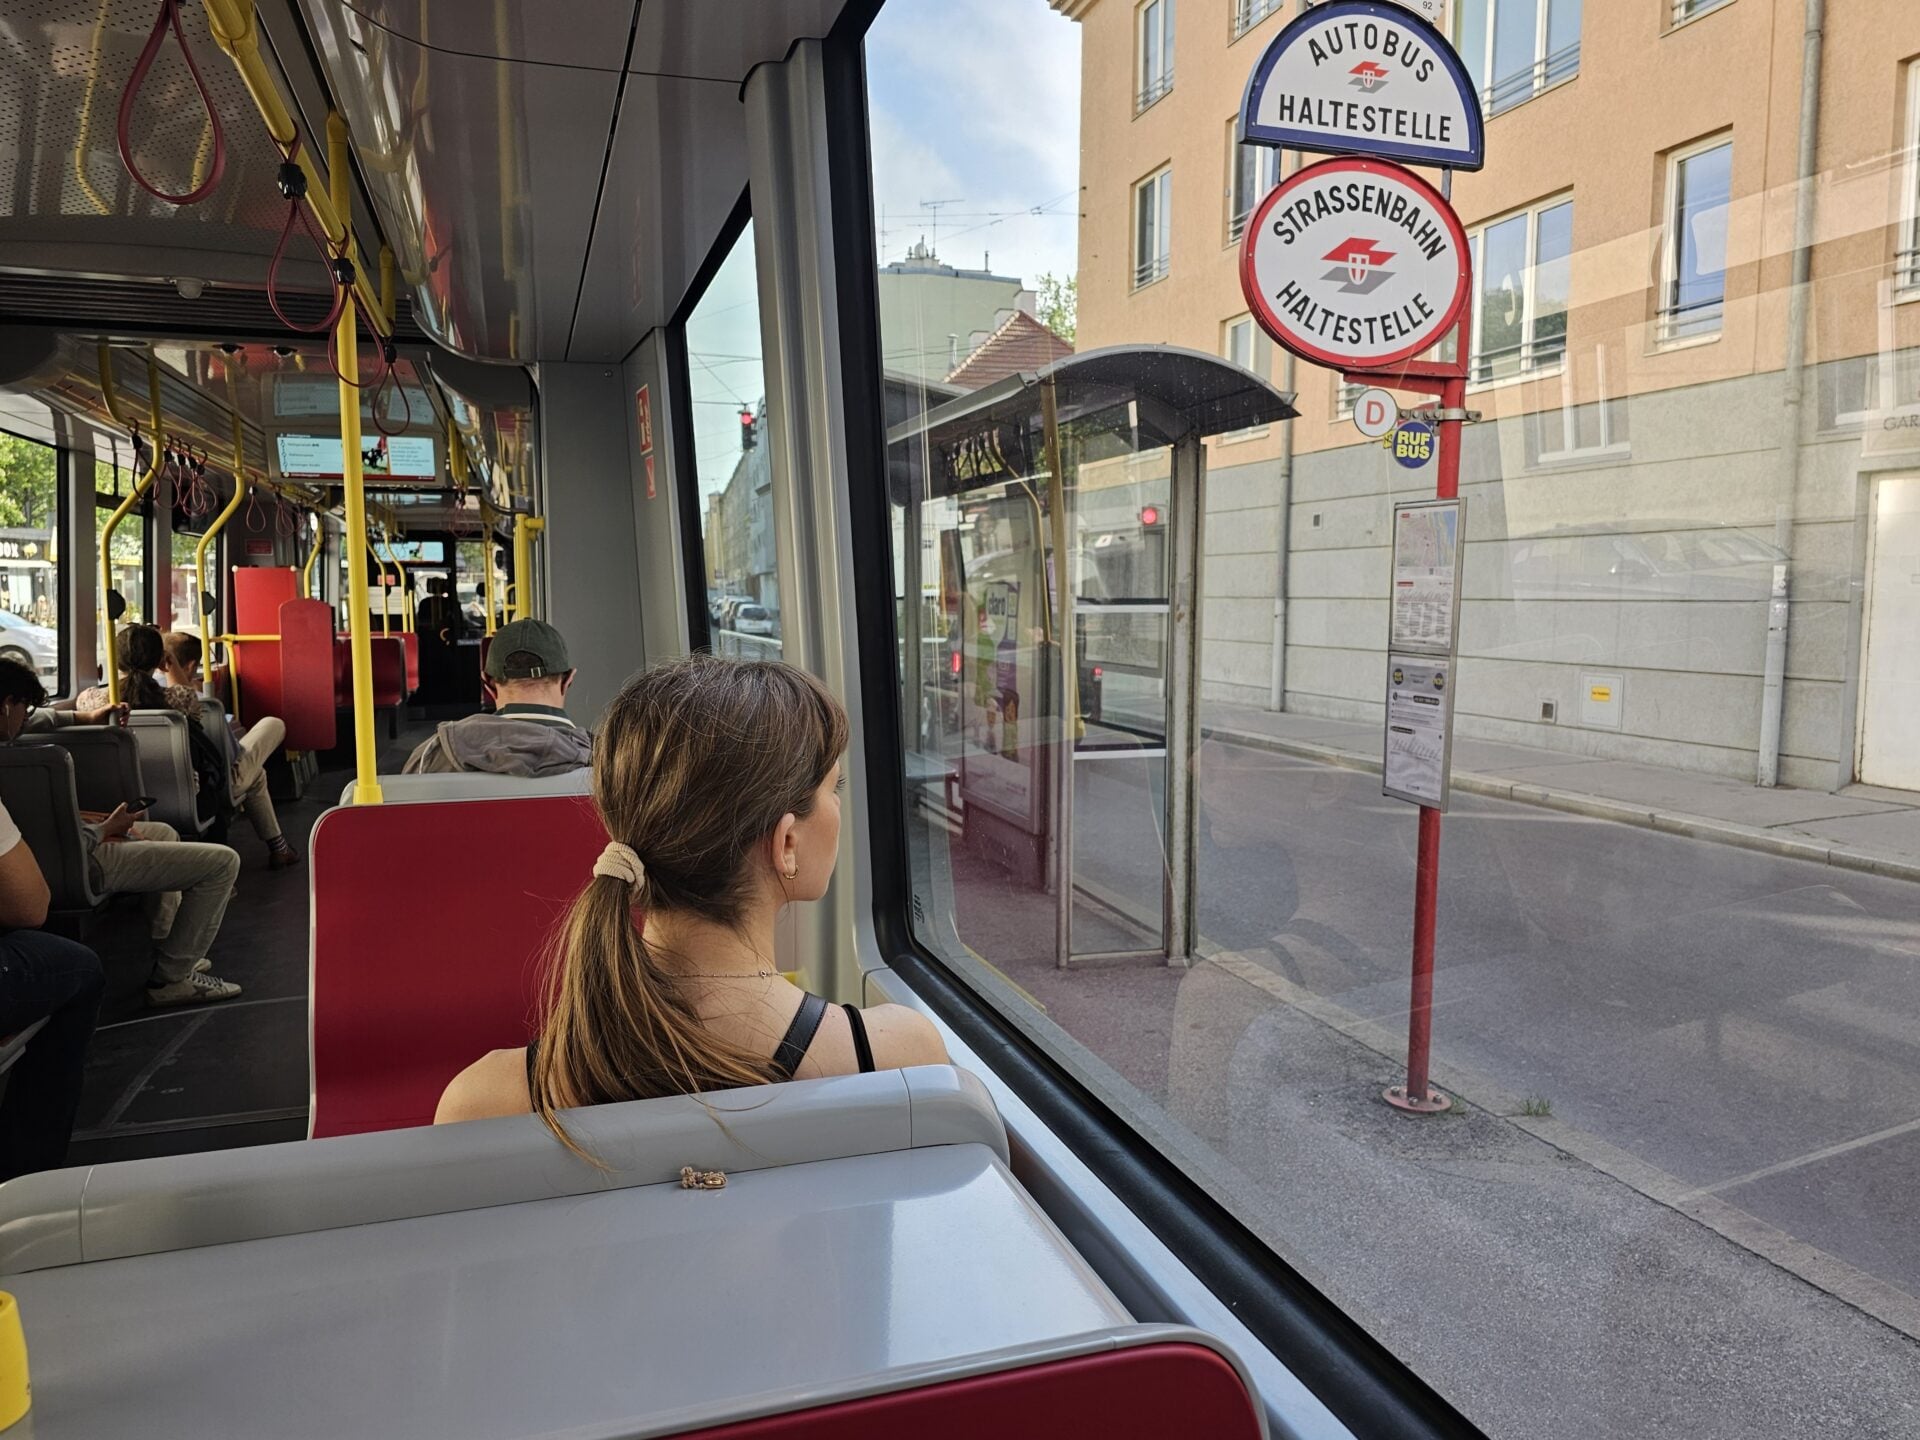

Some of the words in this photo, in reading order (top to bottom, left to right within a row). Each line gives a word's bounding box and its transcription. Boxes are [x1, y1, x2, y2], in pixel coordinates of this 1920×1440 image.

[1422, 1, 1433, 10] 92
[1308, 22, 1434, 82] AUTOBUS
[1279, 94, 1451, 142] HALTESTELLE
[1273, 183, 1446, 261] STRASSENBAHN
[1276, 280, 1434, 344] HALTESTELLE
[1366, 400, 1385, 425] D
[1396, 444, 1430, 459] BUS
[1397, 430, 1430, 446] RUF
